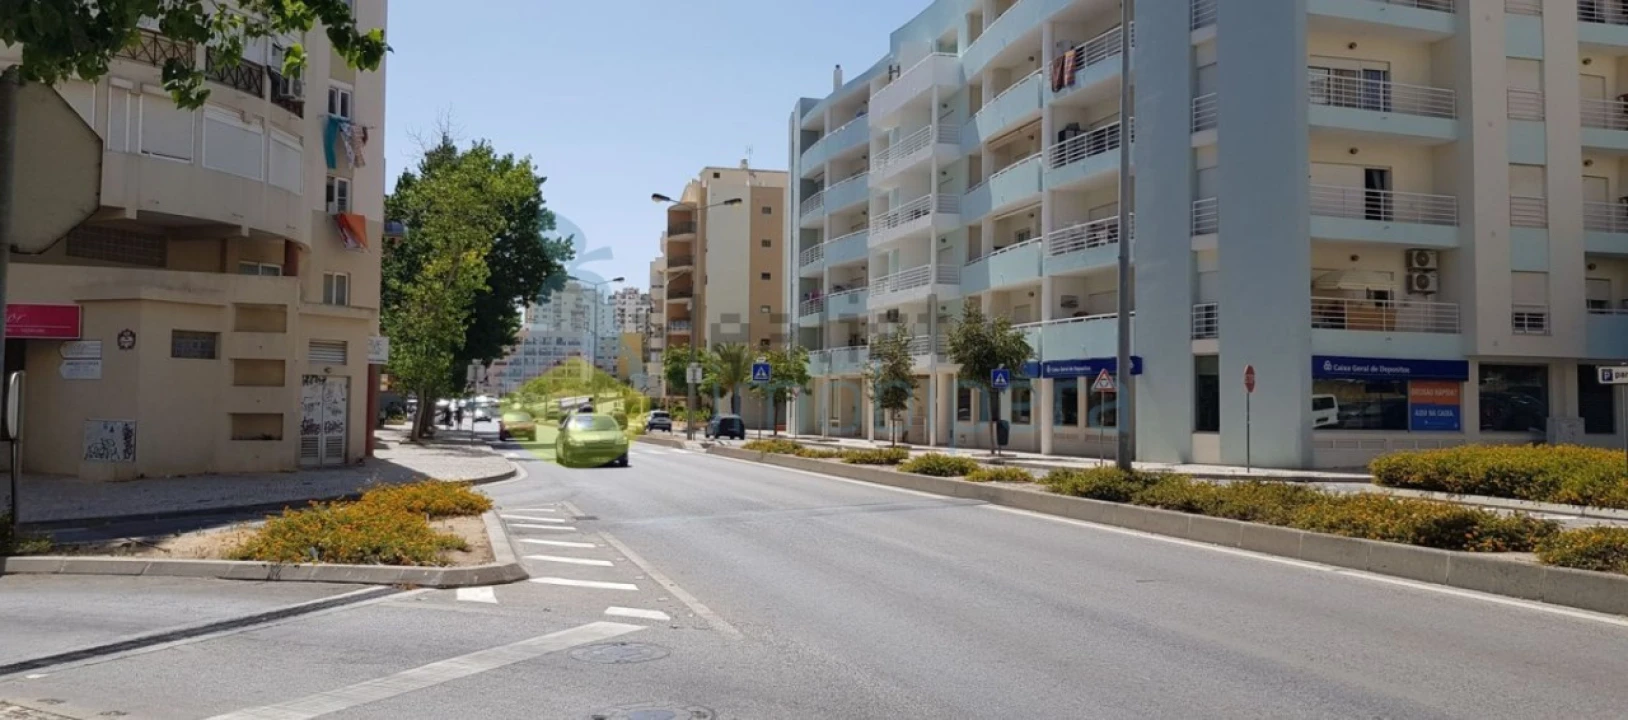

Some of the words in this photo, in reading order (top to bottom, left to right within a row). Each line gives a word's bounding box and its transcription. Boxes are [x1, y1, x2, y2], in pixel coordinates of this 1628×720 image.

[1333, 363, 1351, 372] Caixa
[1352, 364, 1369, 373] Geral
[1370, 364, 1378, 373] de
